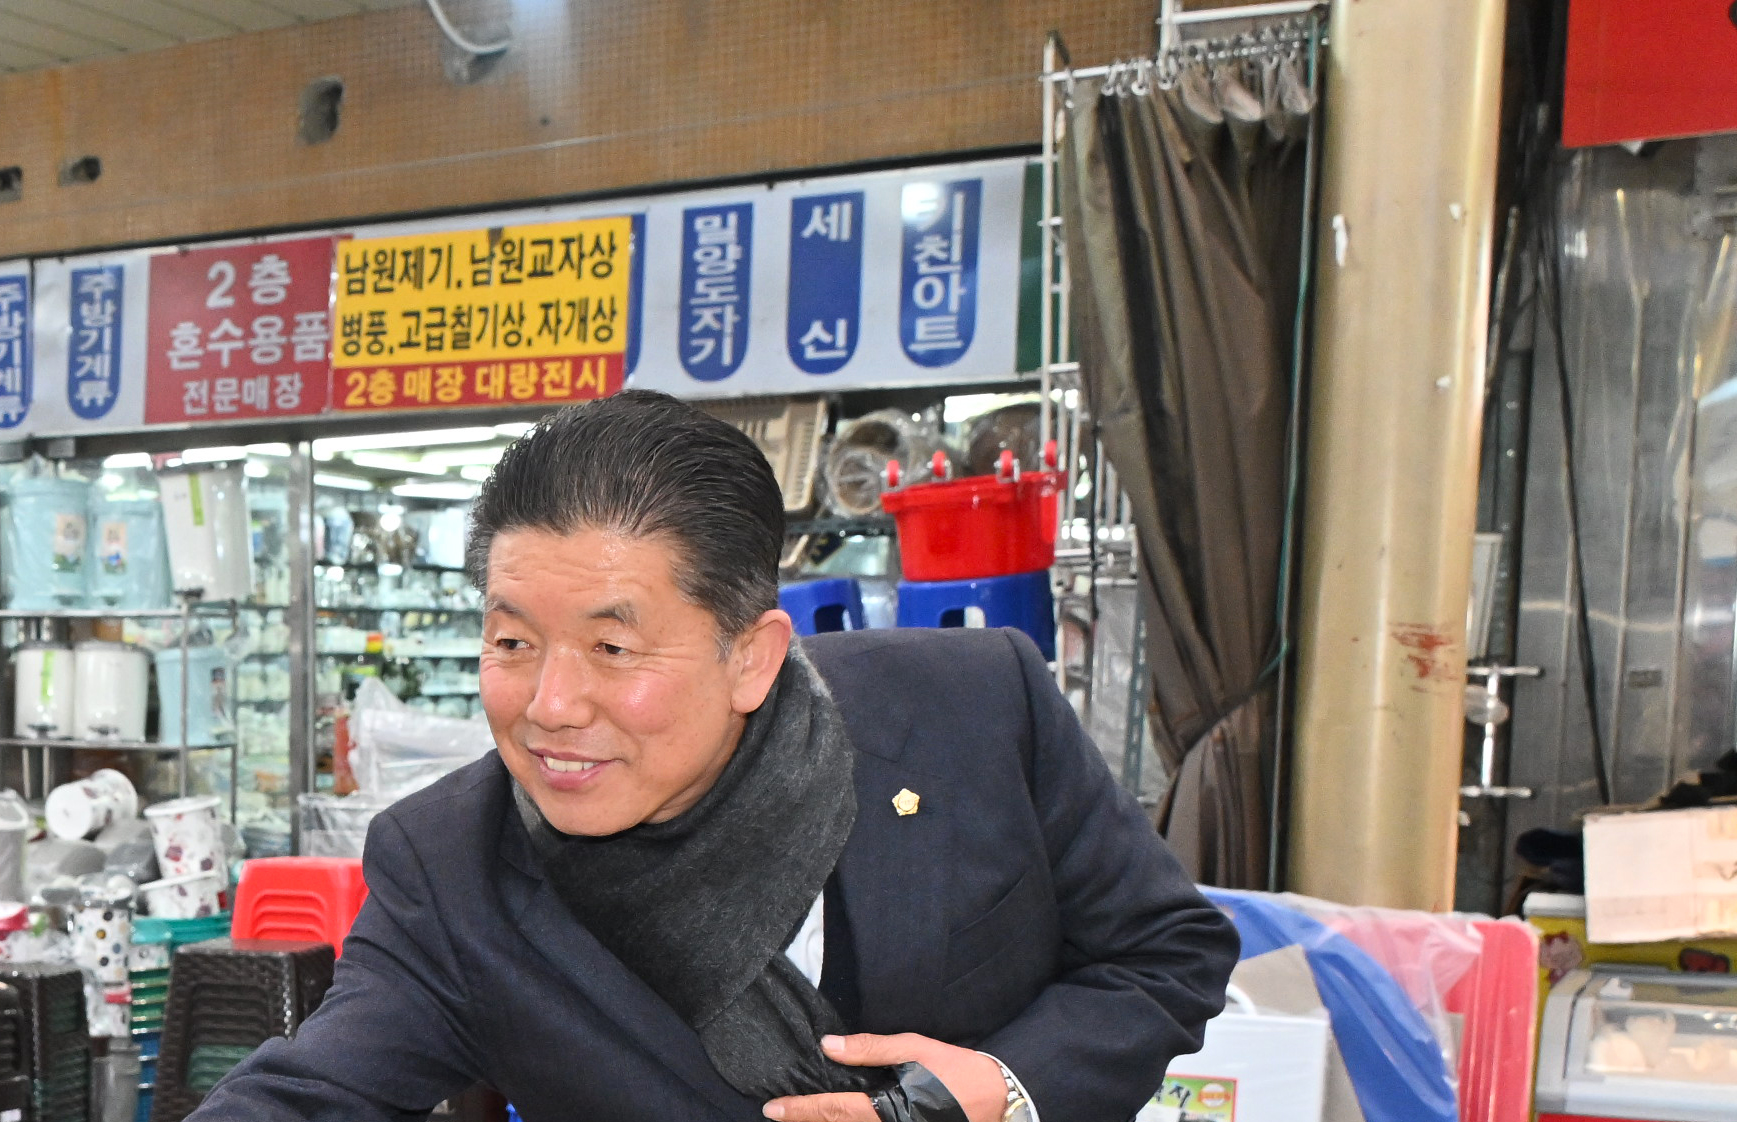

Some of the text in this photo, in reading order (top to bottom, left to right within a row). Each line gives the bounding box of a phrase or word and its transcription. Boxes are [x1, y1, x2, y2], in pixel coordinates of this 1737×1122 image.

[470, 230, 617, 288] 남원교자상
[689, 210, 741, 367] 밀양도자기
[800, 202, 853, 361] 세신
[74, 272, 118, 408] 주방기계류
[167, 311, 331, 371] 혼수용품
[182, 373, 304, 416] 전문매장
[345, 356, 608, 407] 2층 매장 대량전시
